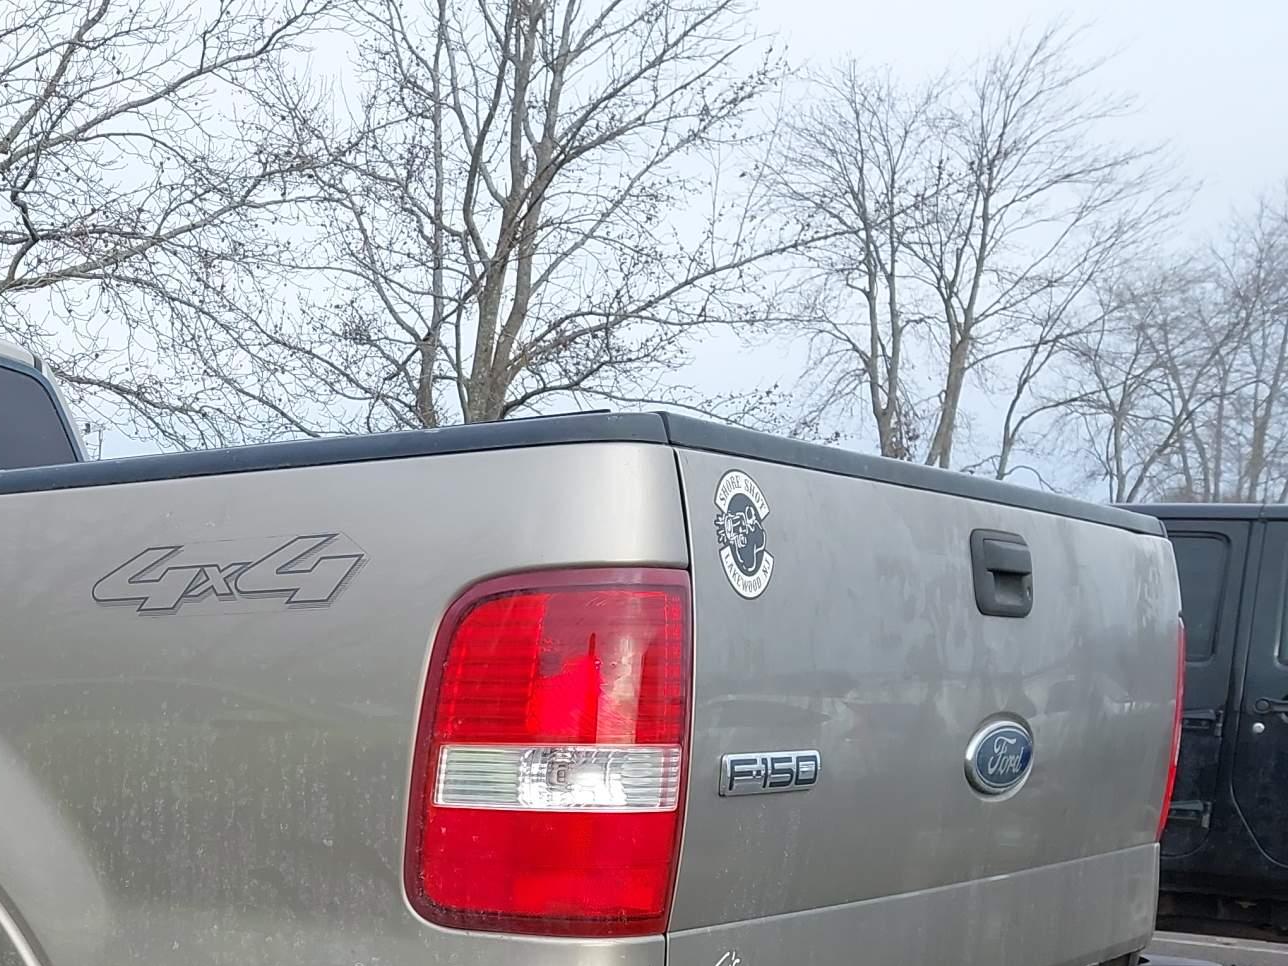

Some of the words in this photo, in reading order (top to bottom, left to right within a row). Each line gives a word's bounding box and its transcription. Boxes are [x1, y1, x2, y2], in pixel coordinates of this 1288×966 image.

[719, 475, 742, 506] SHORE
[724, 553, 762, 592] LAKEWOOD
[988, 736, 1024, 775] Ford
